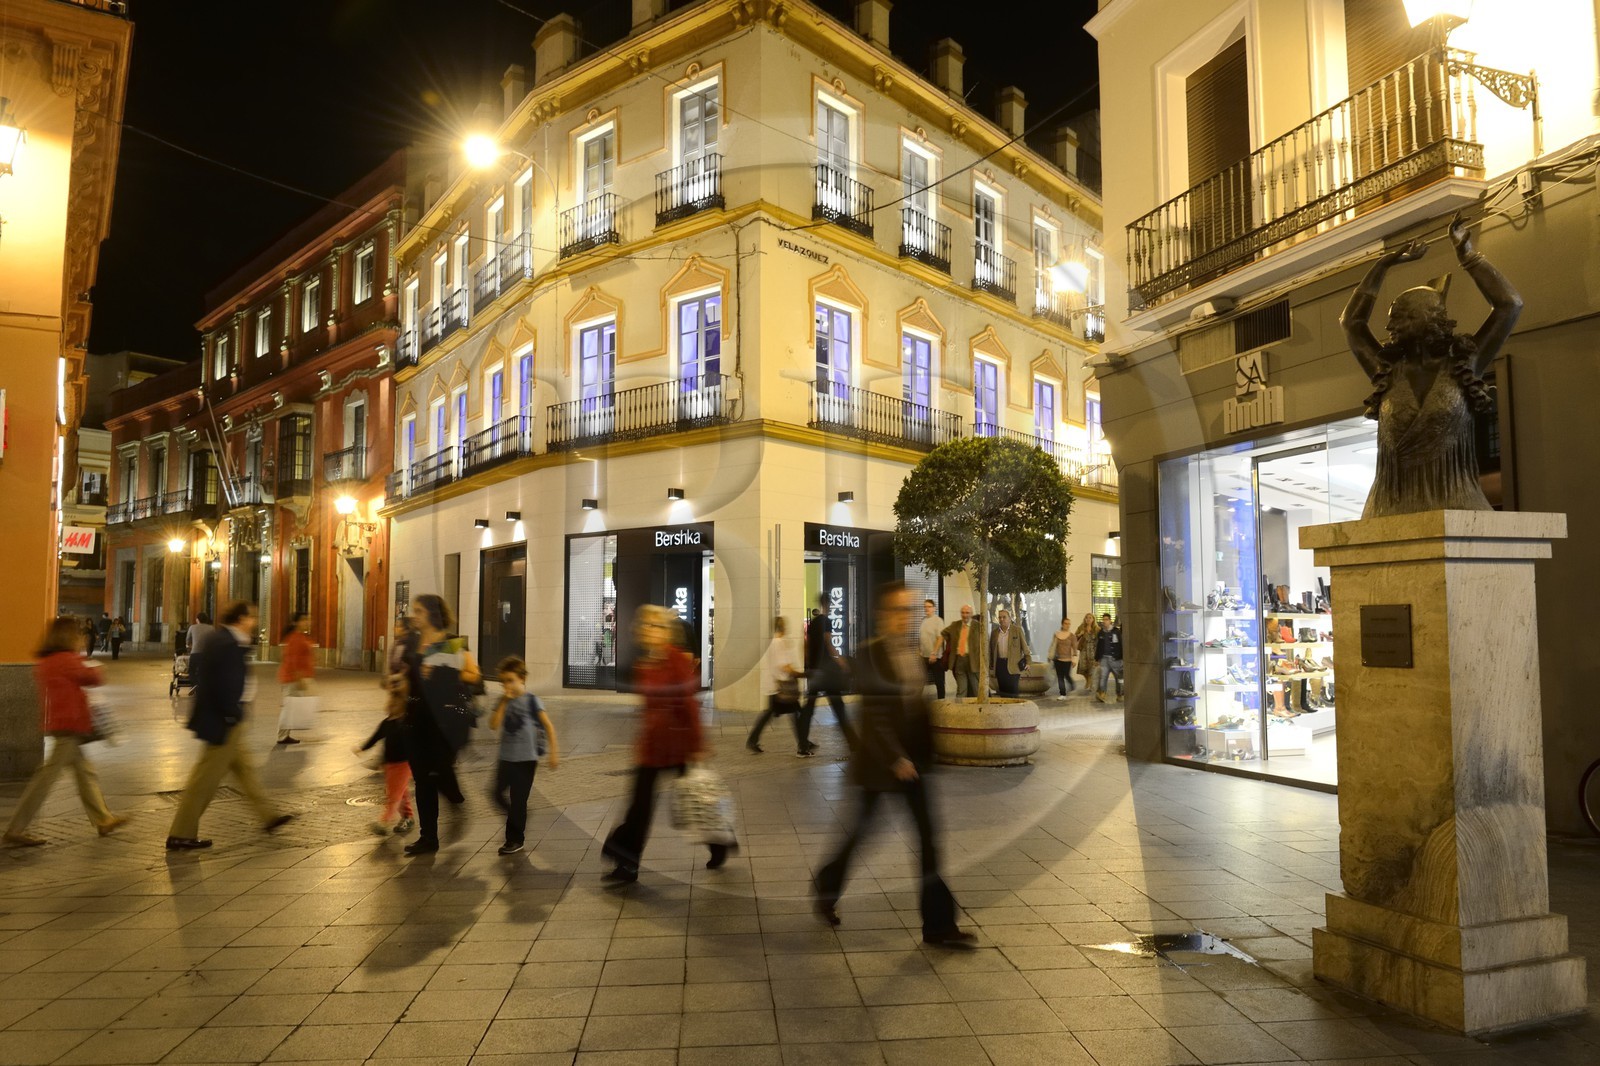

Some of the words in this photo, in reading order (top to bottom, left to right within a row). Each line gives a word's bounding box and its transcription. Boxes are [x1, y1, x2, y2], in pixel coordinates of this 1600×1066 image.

[777, 238, 829, 265] VELAZQUEZ
[64, 532, 93, 549] H&M
[655, 529, 701, 547] Bershka
[819, 529, 860, 548] Bershka
